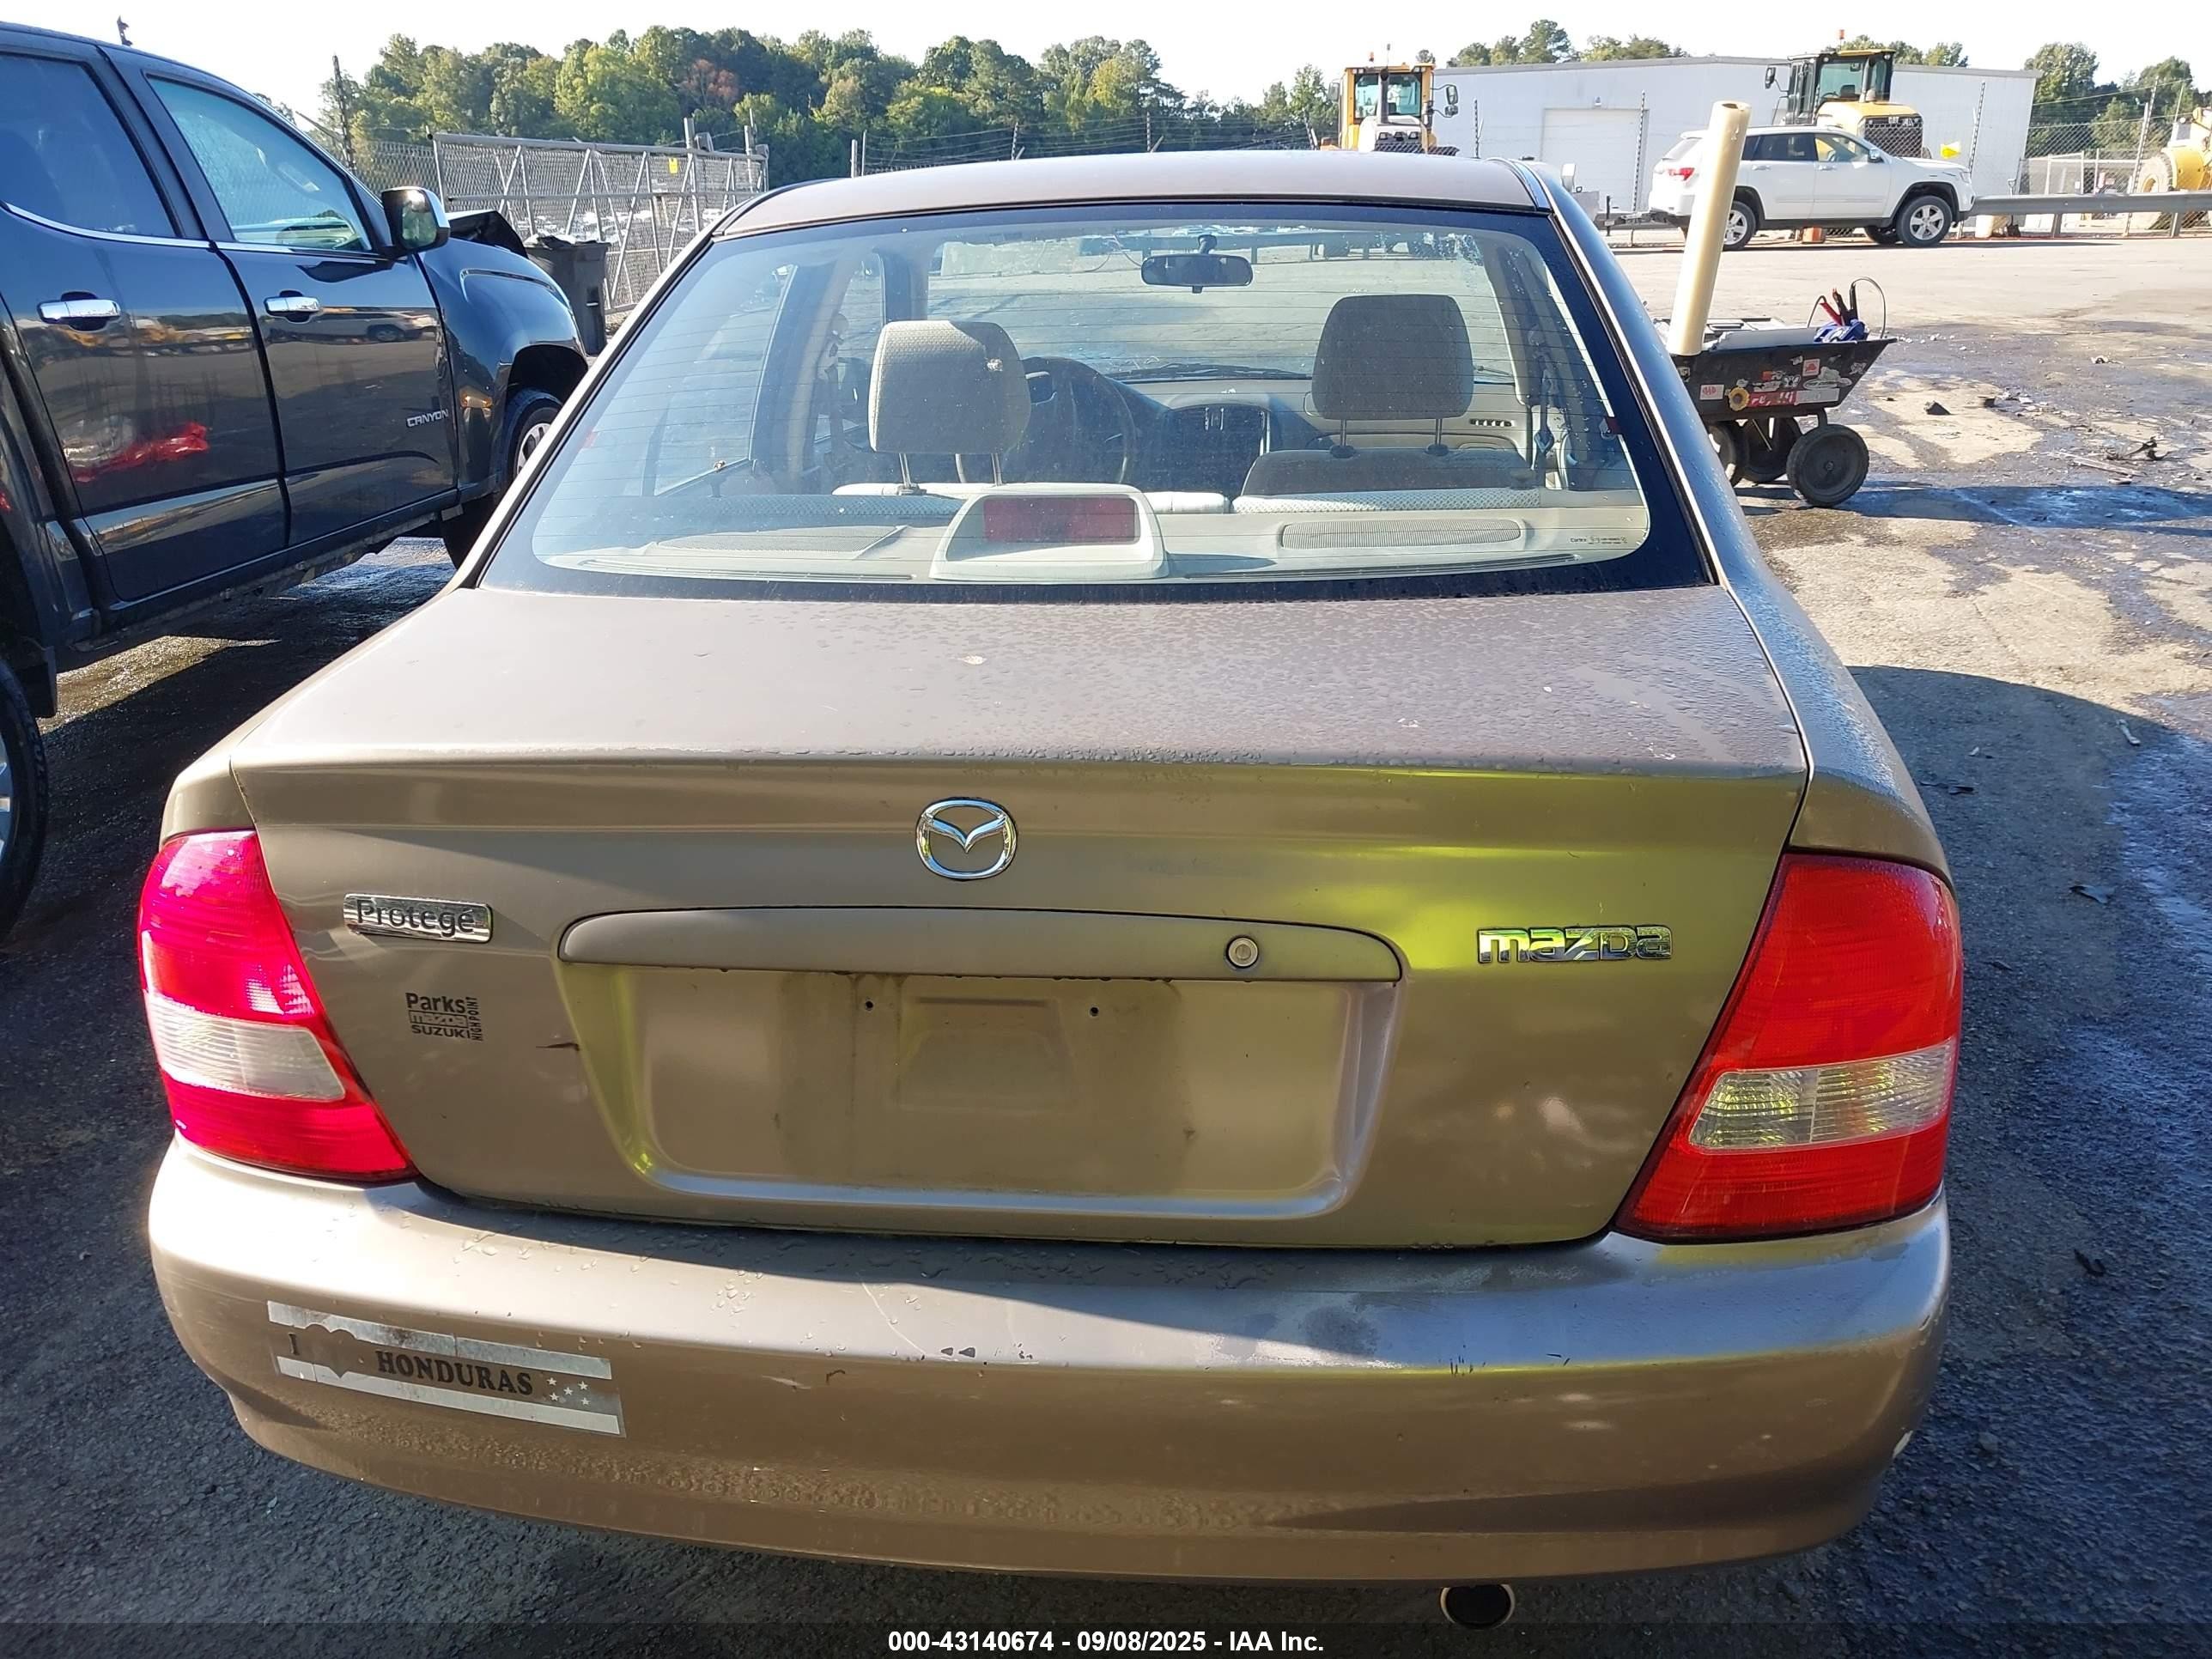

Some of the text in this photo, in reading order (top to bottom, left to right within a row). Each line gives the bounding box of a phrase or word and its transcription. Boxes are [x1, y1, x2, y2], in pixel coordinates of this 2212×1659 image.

[406, 409, 449, 428] CANYON
[1478, 926, 1673, 963] mazda
[405, 992, 466, 1014] Parks
[410, 1024, 471, 1039] SUZUKI
[374, 1349, 533, 1396] HONDURAS
